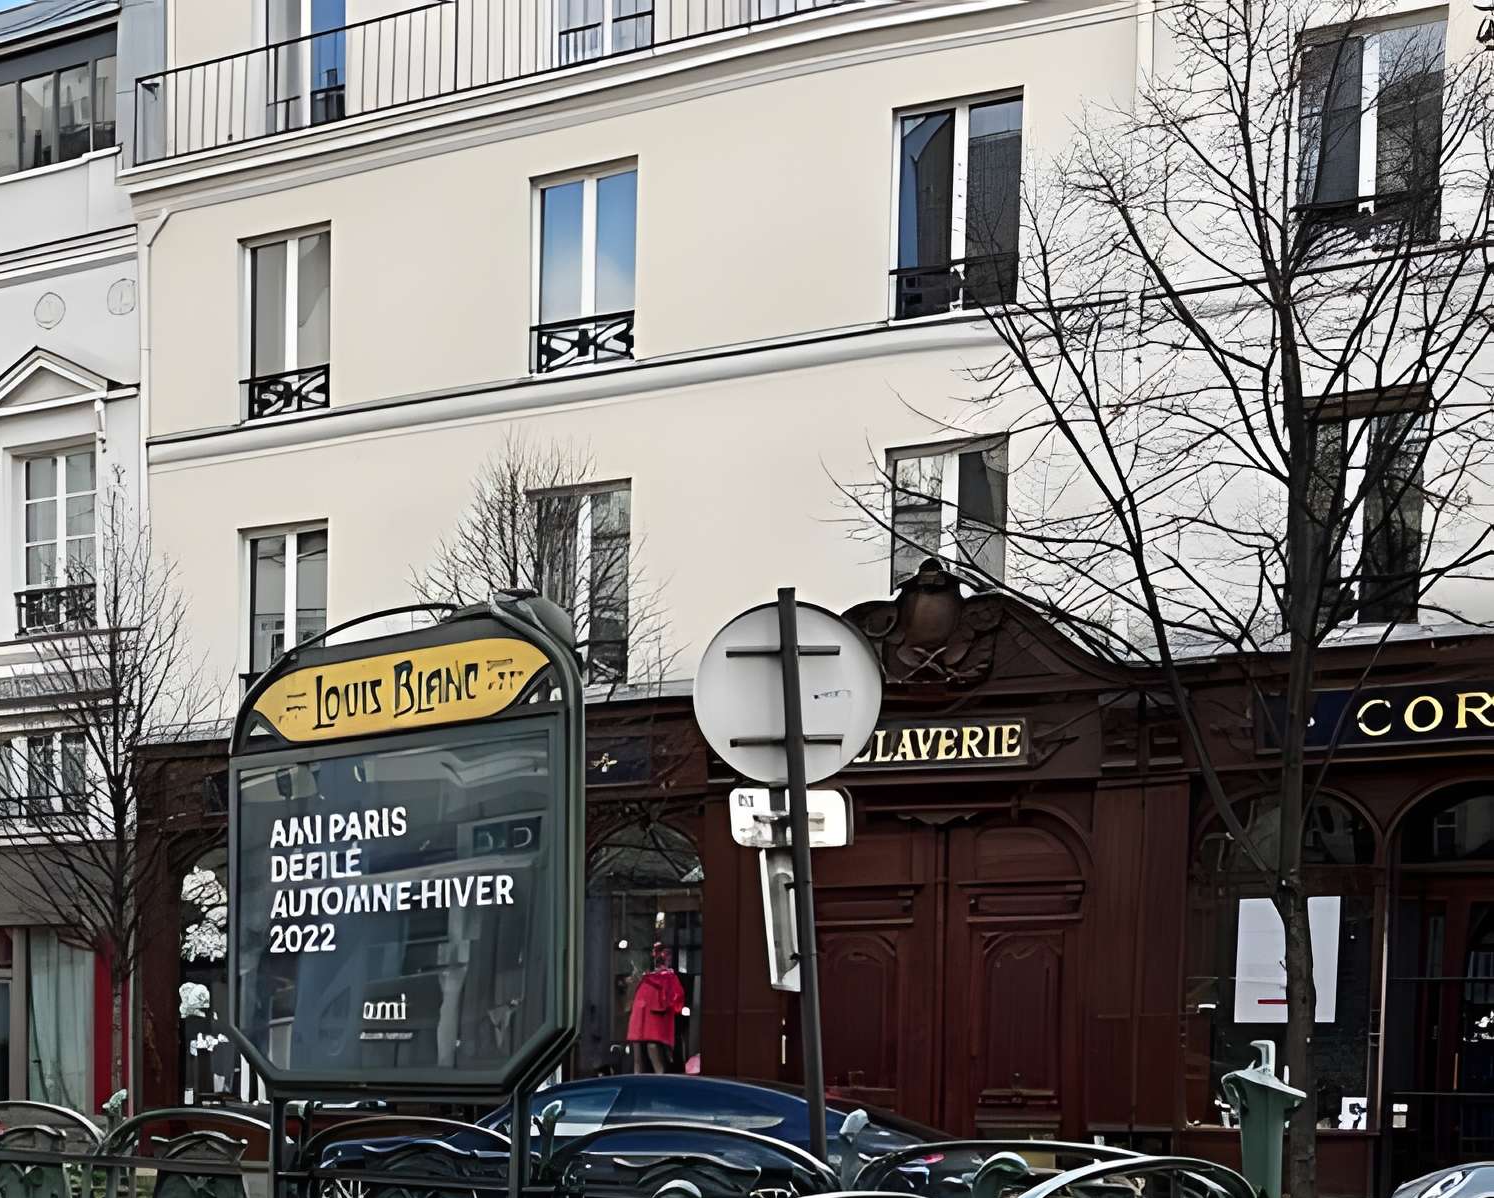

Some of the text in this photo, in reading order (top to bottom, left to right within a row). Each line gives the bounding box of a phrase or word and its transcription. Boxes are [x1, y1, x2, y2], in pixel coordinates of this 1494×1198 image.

[1356, 692, 1494, 737] COR
[853, 724, 1022, 764] LAVERIE
[269, 806, 408, 849] AMI PARIS
[269, 874, 515, 920] AUTOMNE-HIVER
[269, 923, 337, 954] 2022
